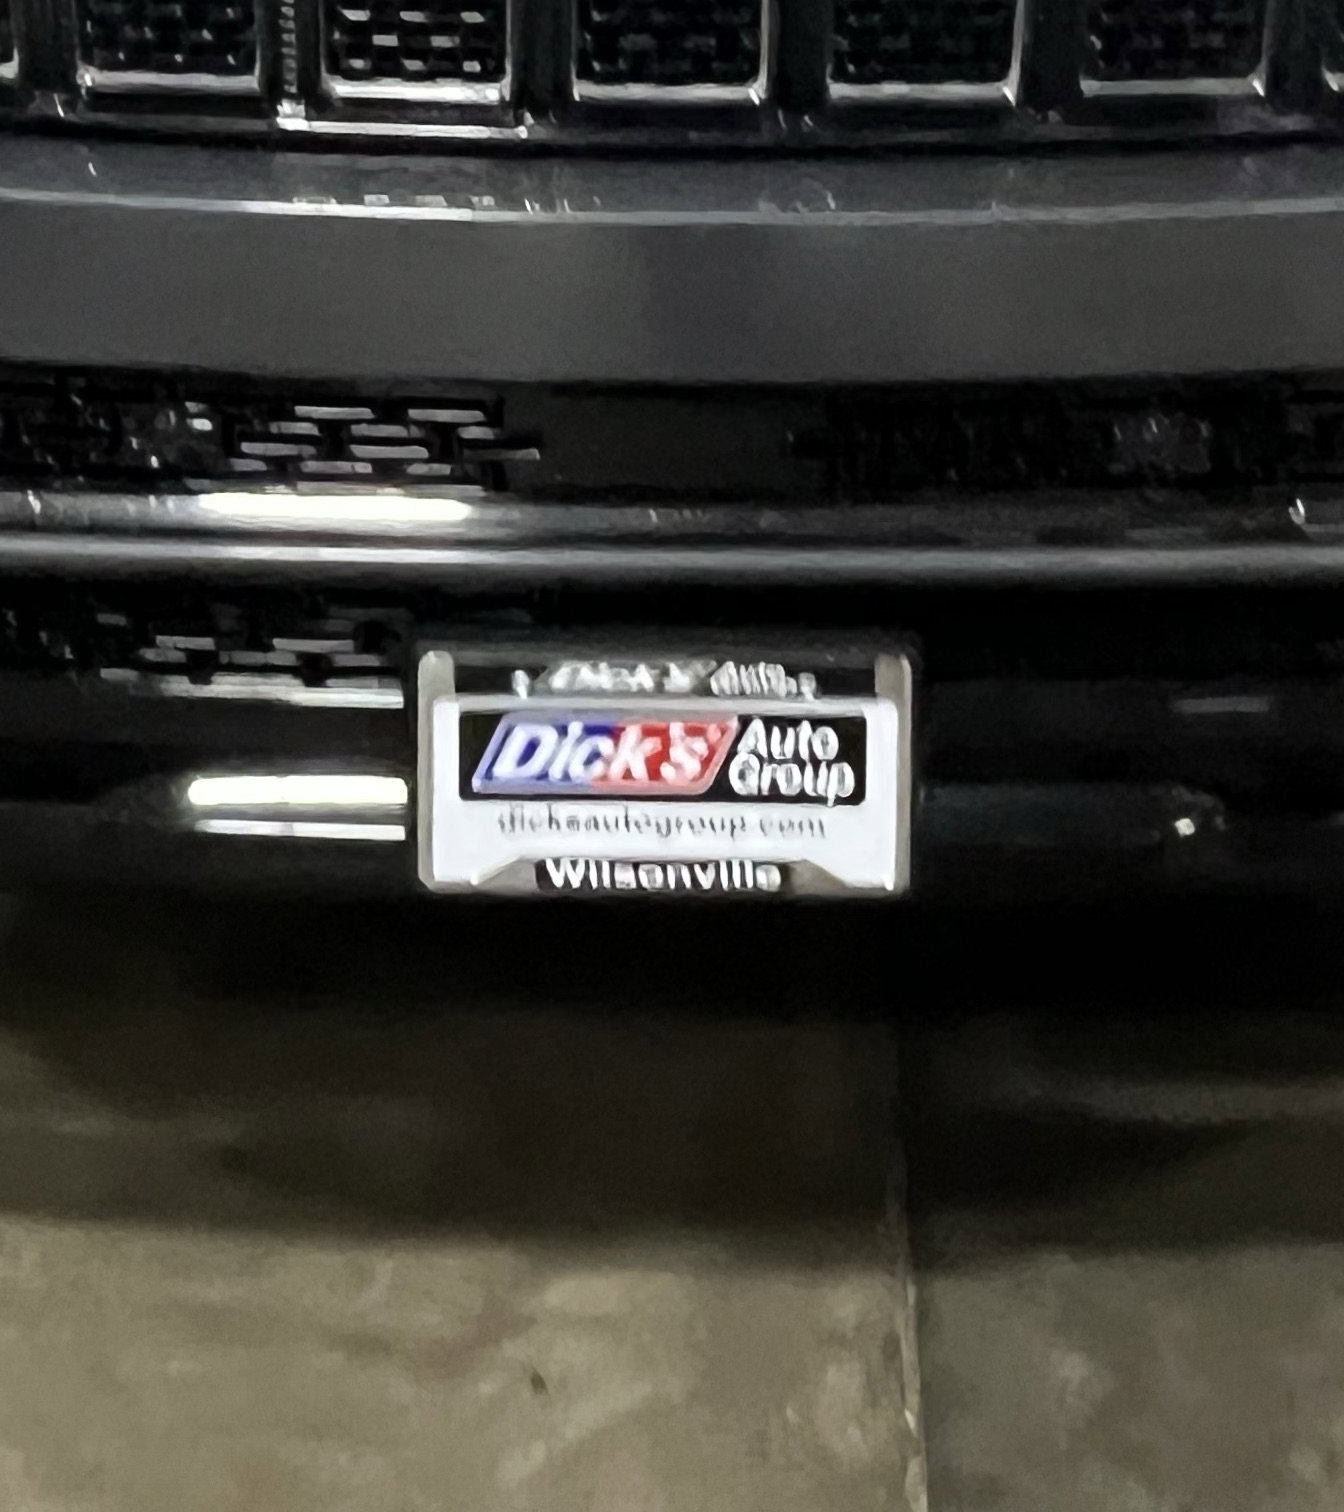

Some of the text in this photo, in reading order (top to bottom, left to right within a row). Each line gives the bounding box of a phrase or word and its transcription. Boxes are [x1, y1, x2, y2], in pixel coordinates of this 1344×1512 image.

[493, 718, 839, 785] Dick's Auto
[729, 752, 855, 807] Group
